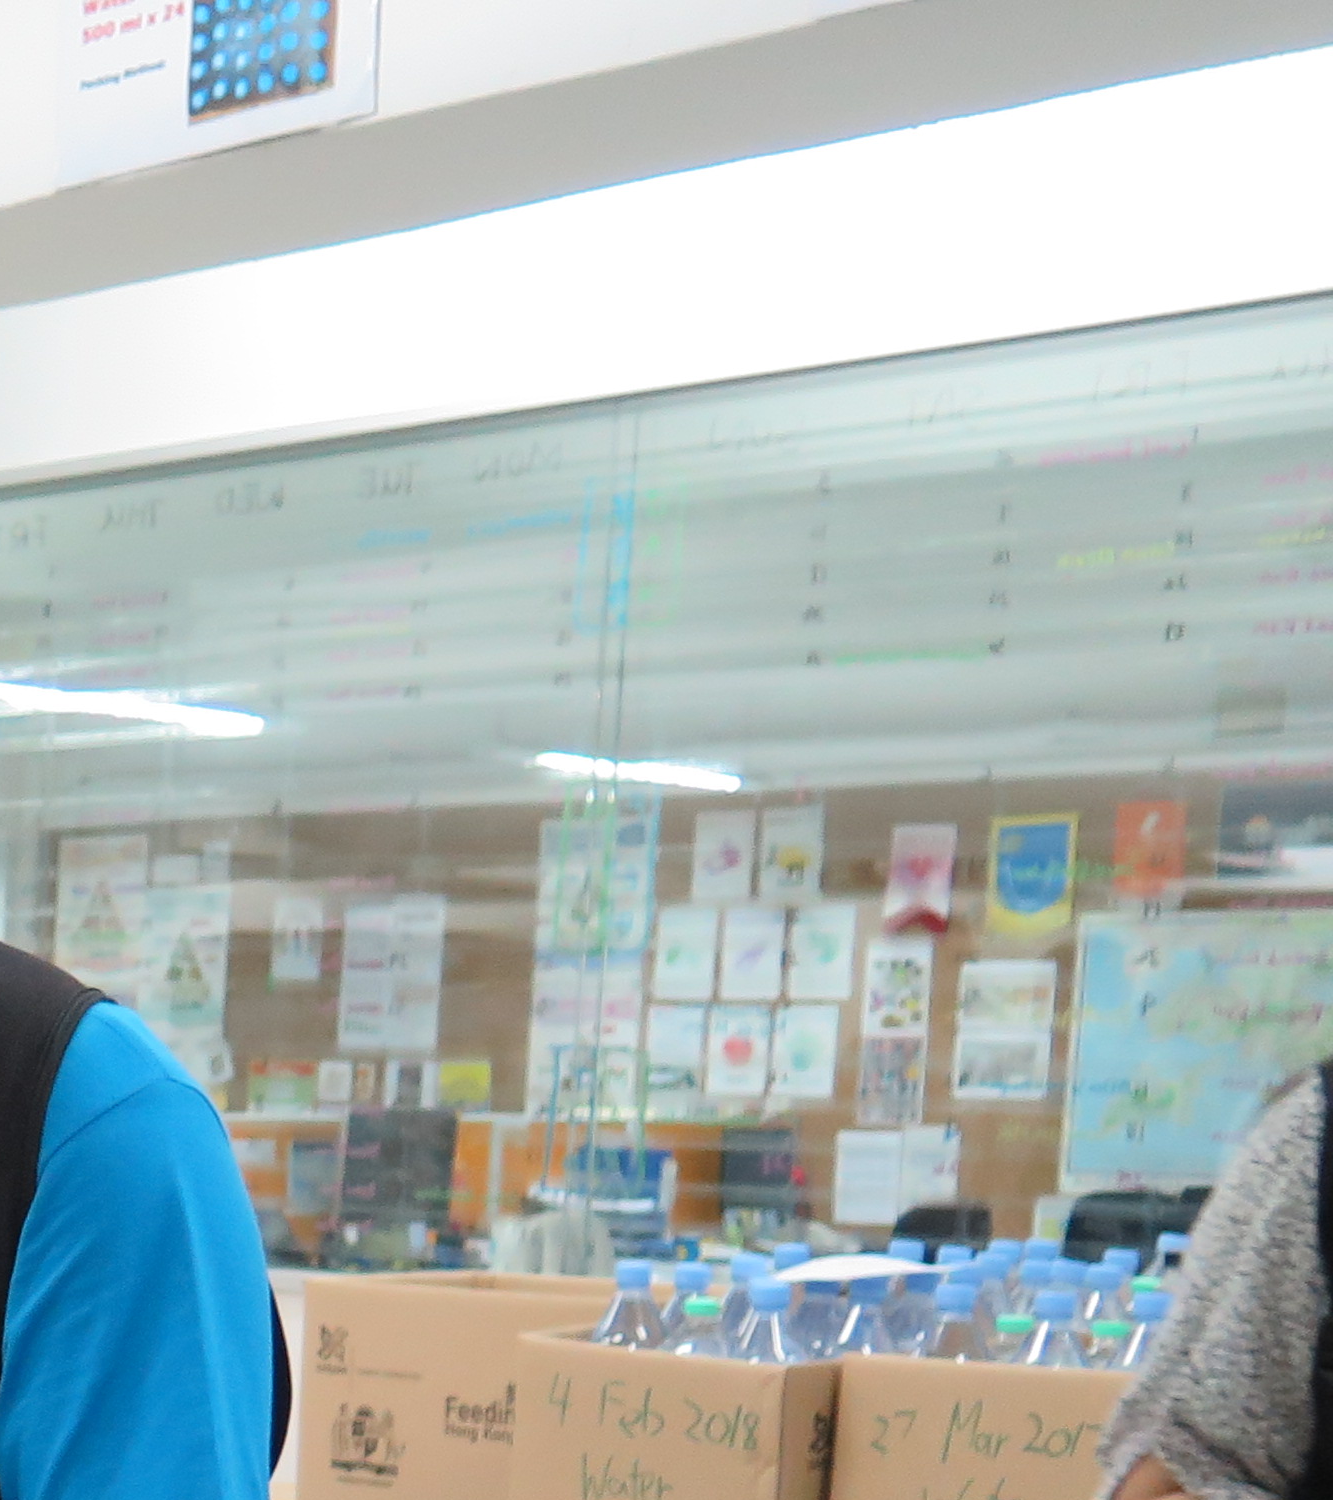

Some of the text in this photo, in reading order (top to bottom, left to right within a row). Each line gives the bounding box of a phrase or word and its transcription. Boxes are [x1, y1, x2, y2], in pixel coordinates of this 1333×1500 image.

[546, 1372, 572, 1424] 4
[597, 1380, 666, 1439] Feb
[684, 1394, 763, 1452] 2018
[870, 1410, 916, 1456] 27
[940, 1400, 1009, 1465] Mar
